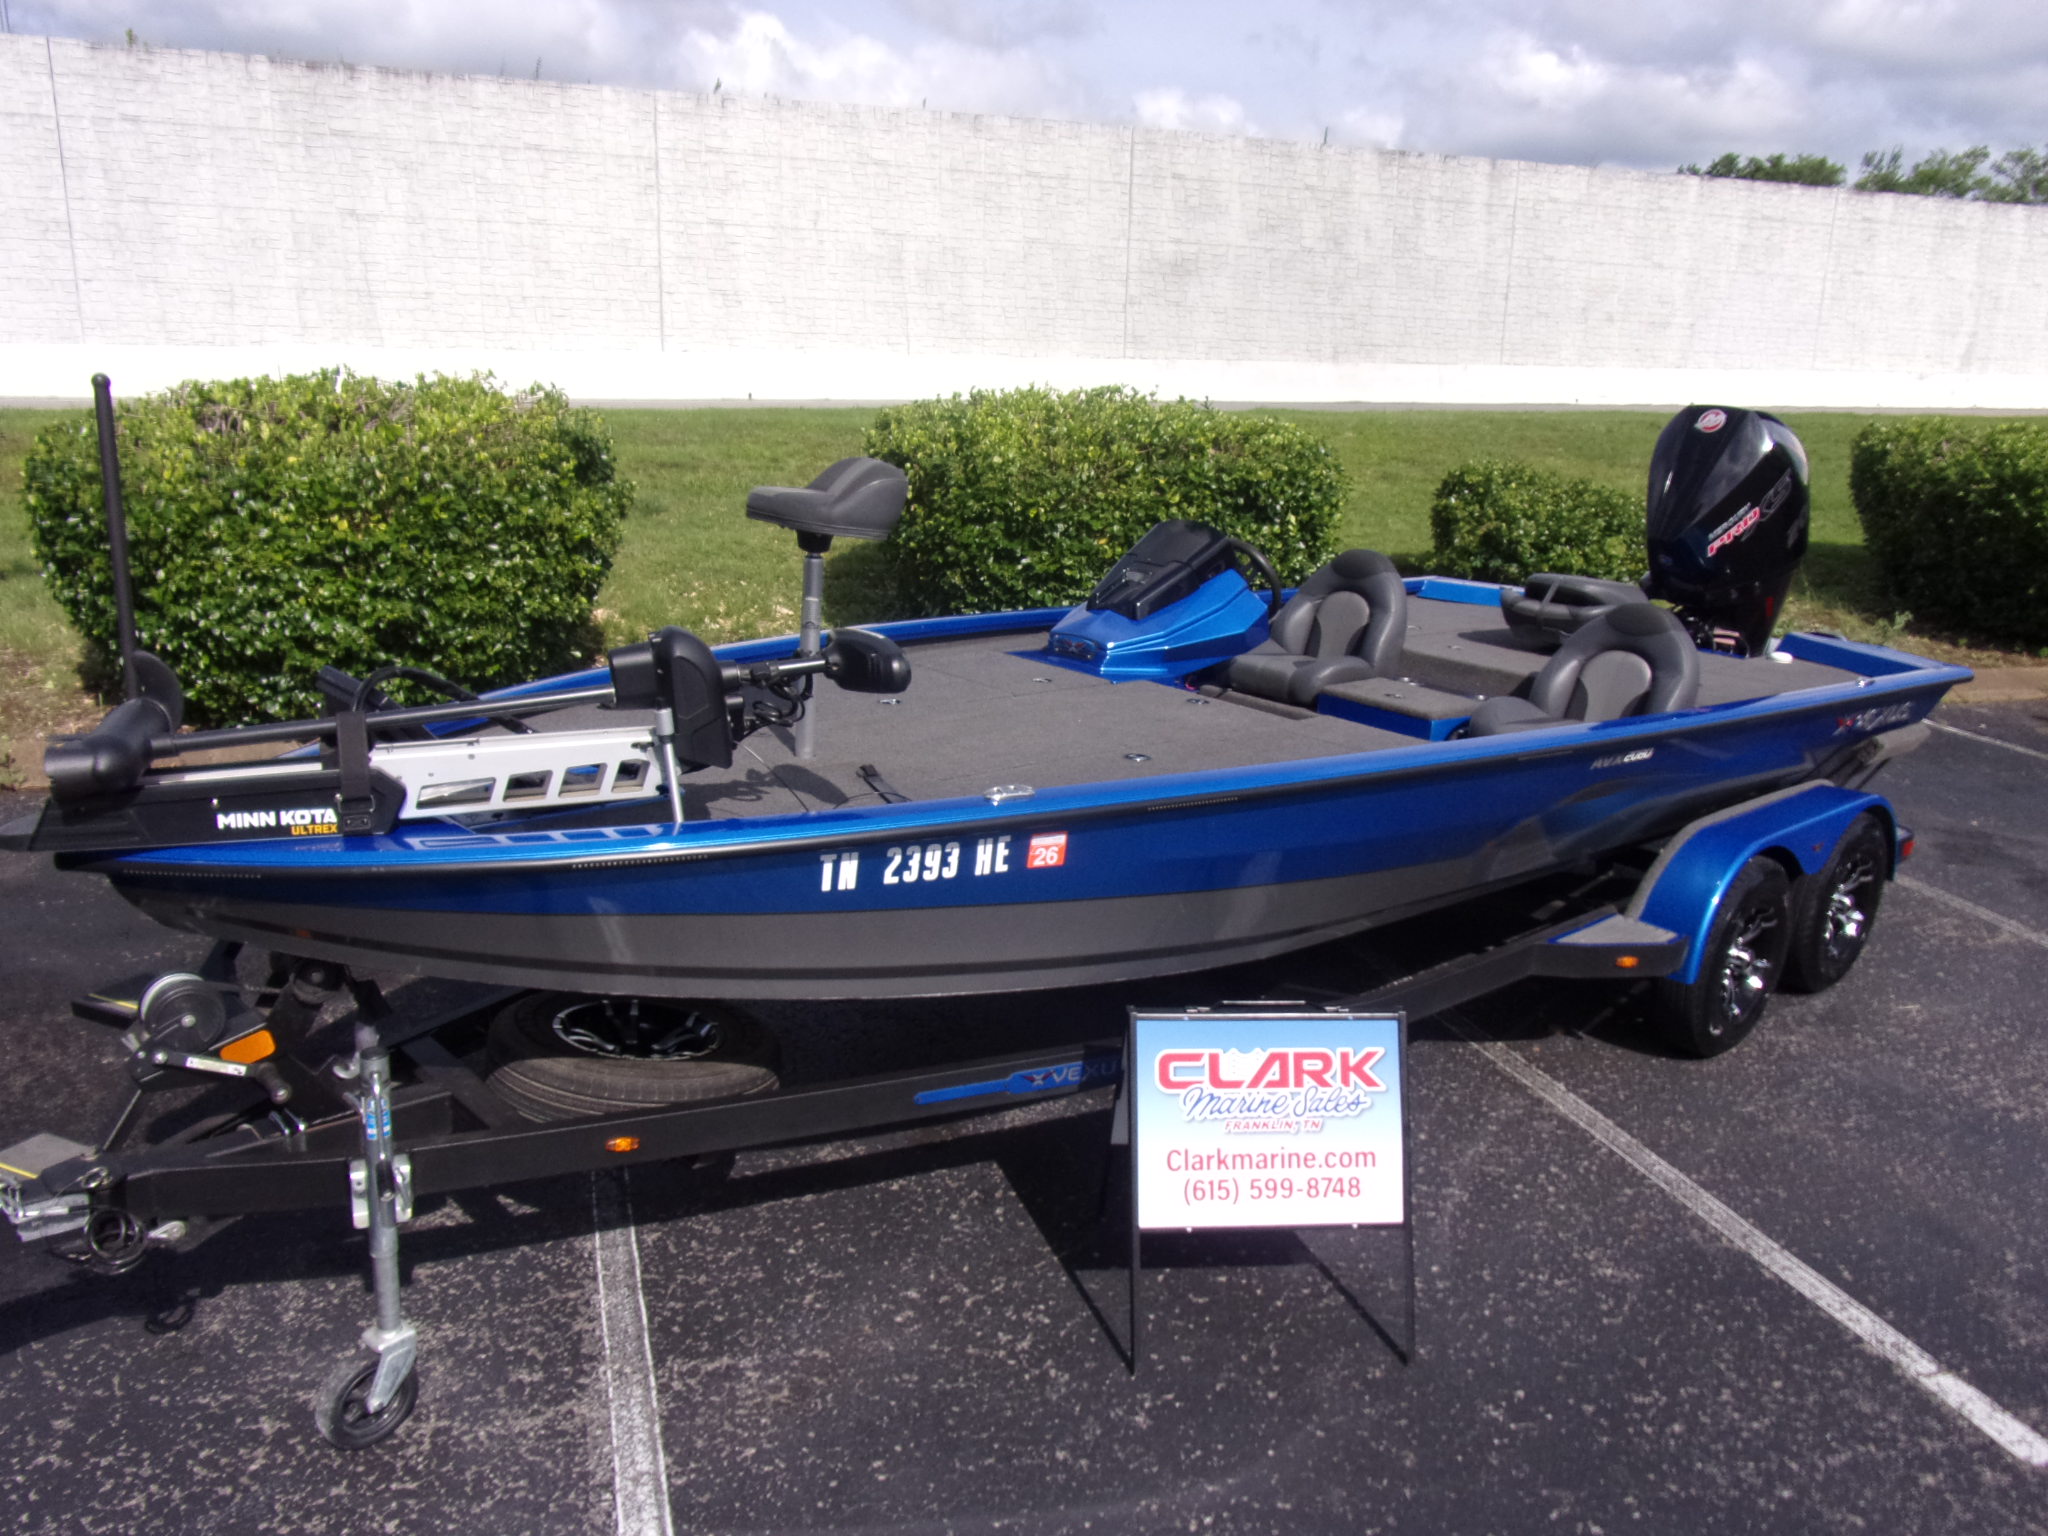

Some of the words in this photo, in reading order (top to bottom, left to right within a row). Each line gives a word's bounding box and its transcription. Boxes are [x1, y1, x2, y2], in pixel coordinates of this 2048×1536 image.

[216, 811, 276, 830] MINN
[279, 808, 338, 826] KOTA
[291, 823, 338, 836] ULTREX
[820, 851, 859, 892] TN
[883, 842, 960, 885] 2393
[974, 836, 1011, 876] HE
[1033, 846, 1059, 866] 26
[1158, 1051, 1383, 1090] CLARK
[1183, 1086, 1289, 1117] Marine
[1294, 1085, 1368, 1118] Sales
[1302, 1118, 1321, 1130] TN
[1166, 1147, 1377, 1172] Clarkmarine.com
[1184, 1177, 1240, 1206] (615)
[1249, 1176, 1362, 1200] 599-8748
